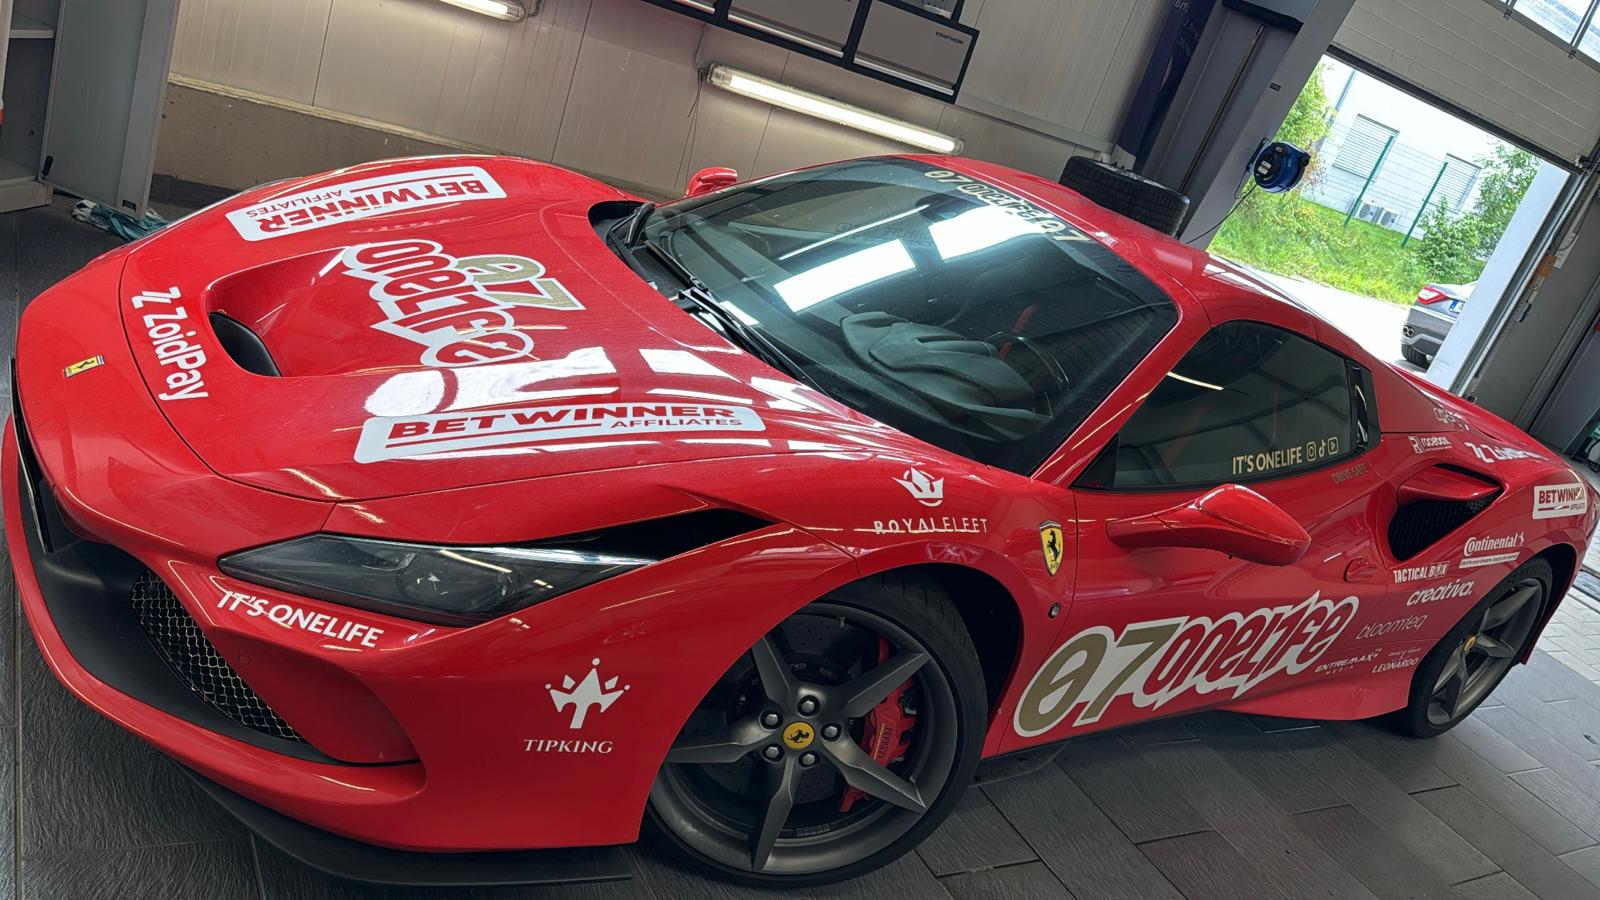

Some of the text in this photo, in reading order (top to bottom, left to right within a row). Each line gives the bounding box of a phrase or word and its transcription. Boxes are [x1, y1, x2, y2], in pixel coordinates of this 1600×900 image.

[246, 189, 342, 217] AFFILIATES
[258, 179, 489, 233] BETWINNER
[142, 306, 208, 401] ZoidPay
[387, 405, 735, 440] BETWINNER
[611, 417, 742, 429] AFFILIATES
[1232, 446, 1303, 475] IT'S ONELIFE
[1463, 532, 1518, 557] Continental
[1393, 567, 1428, 583] TACTICAL
[1406, 578, 1475, 607] creativa.
[217, 591, 384, 648] IT'S ONELIFE
[1371, 658, 1420, 674] LEONARDO
[524, 739, 613, 754] TIPKING
